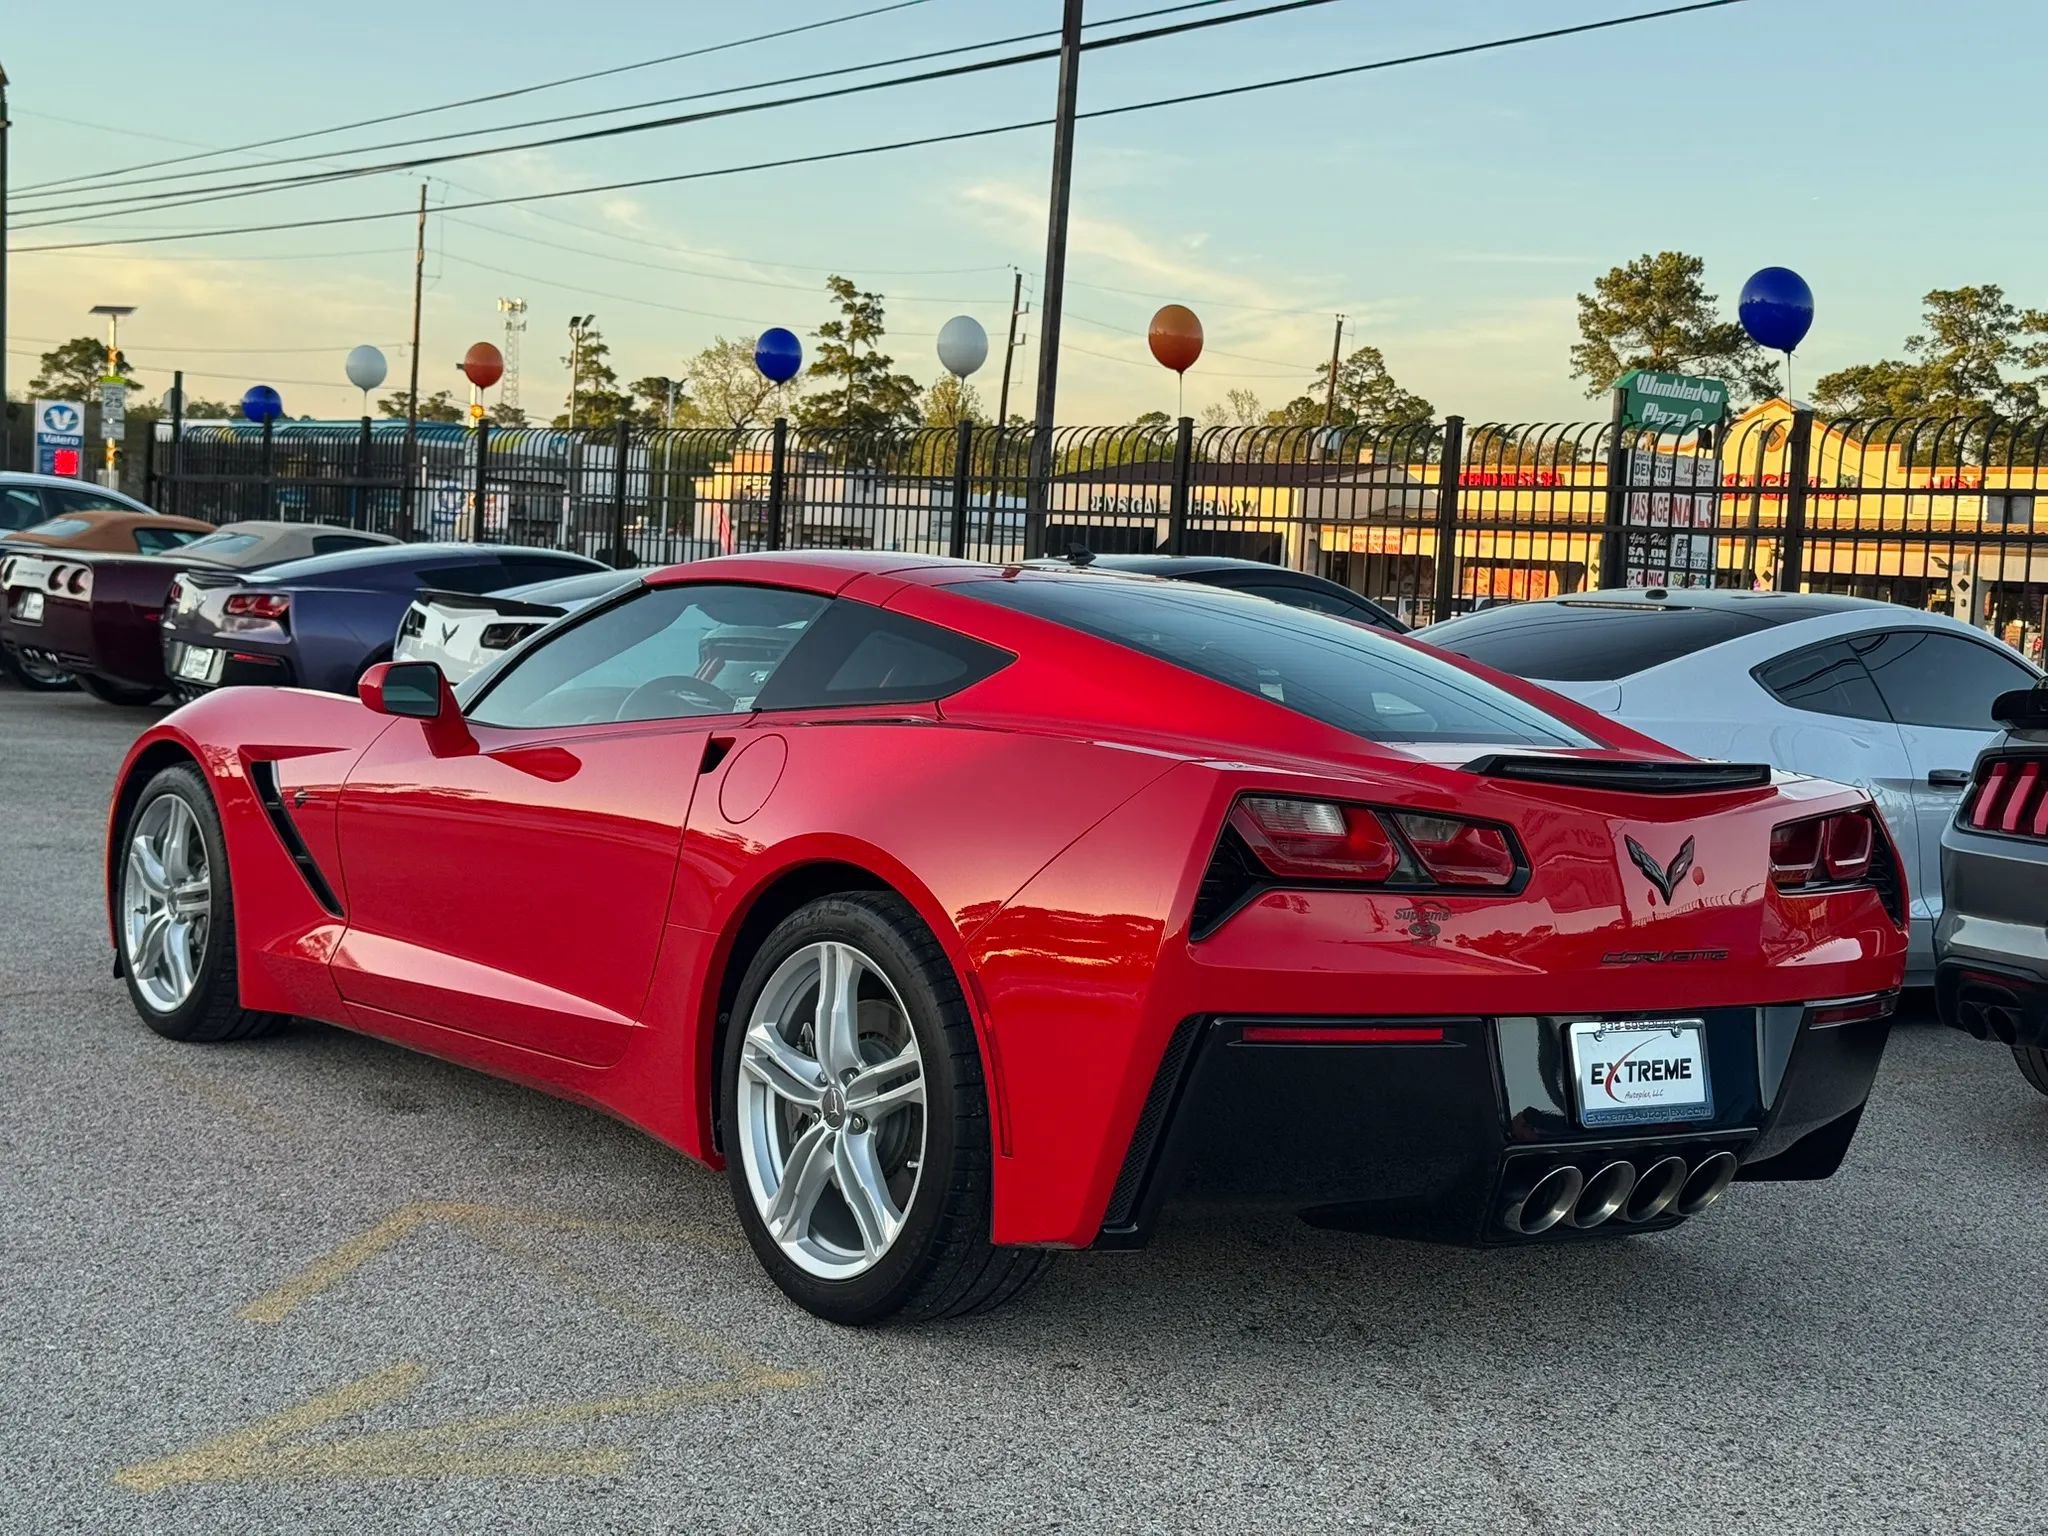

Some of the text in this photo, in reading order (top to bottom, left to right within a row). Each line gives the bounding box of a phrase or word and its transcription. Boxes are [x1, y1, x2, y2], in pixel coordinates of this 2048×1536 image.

[1636, 373, 1721, 403] Wimbledon
[1641, 402, 1688, 427] Plaza
[43, 434, 80, 446] Valero
[1628, 546, 1667, 558] SAON
[1591, 1058, 1692, 1085] EXTREME
